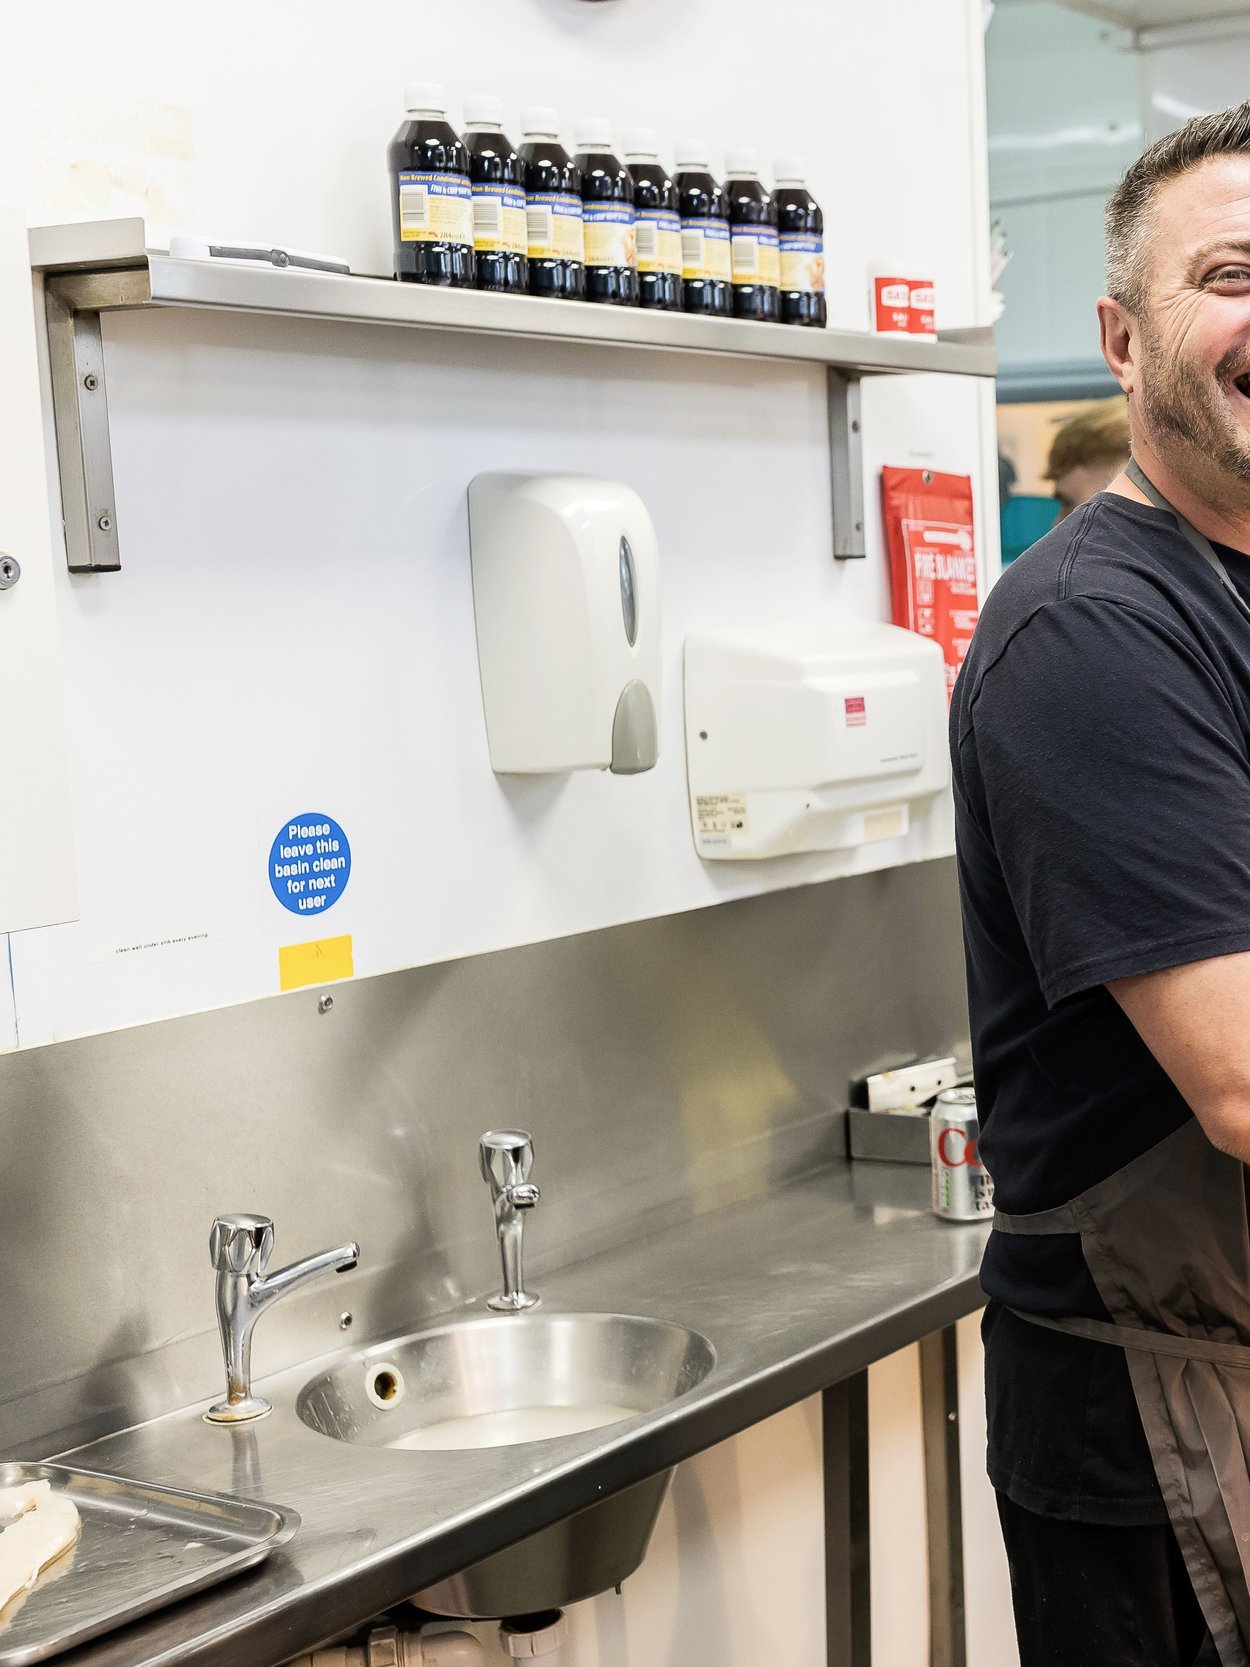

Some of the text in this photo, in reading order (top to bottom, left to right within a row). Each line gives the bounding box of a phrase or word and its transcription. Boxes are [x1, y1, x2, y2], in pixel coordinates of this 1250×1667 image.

[434, 175, 461, 183] Condiment
[913, 553, 934, 579] FIRE
[288, 823, 331, 840] Please
[279, 837, 340, 859] leave this
[274, 855, 346, 878] basin clean
[286, 873, 336, 894] for next
[297, 894, 327, 910] user
[937, 1127, 984, 1168] Co
